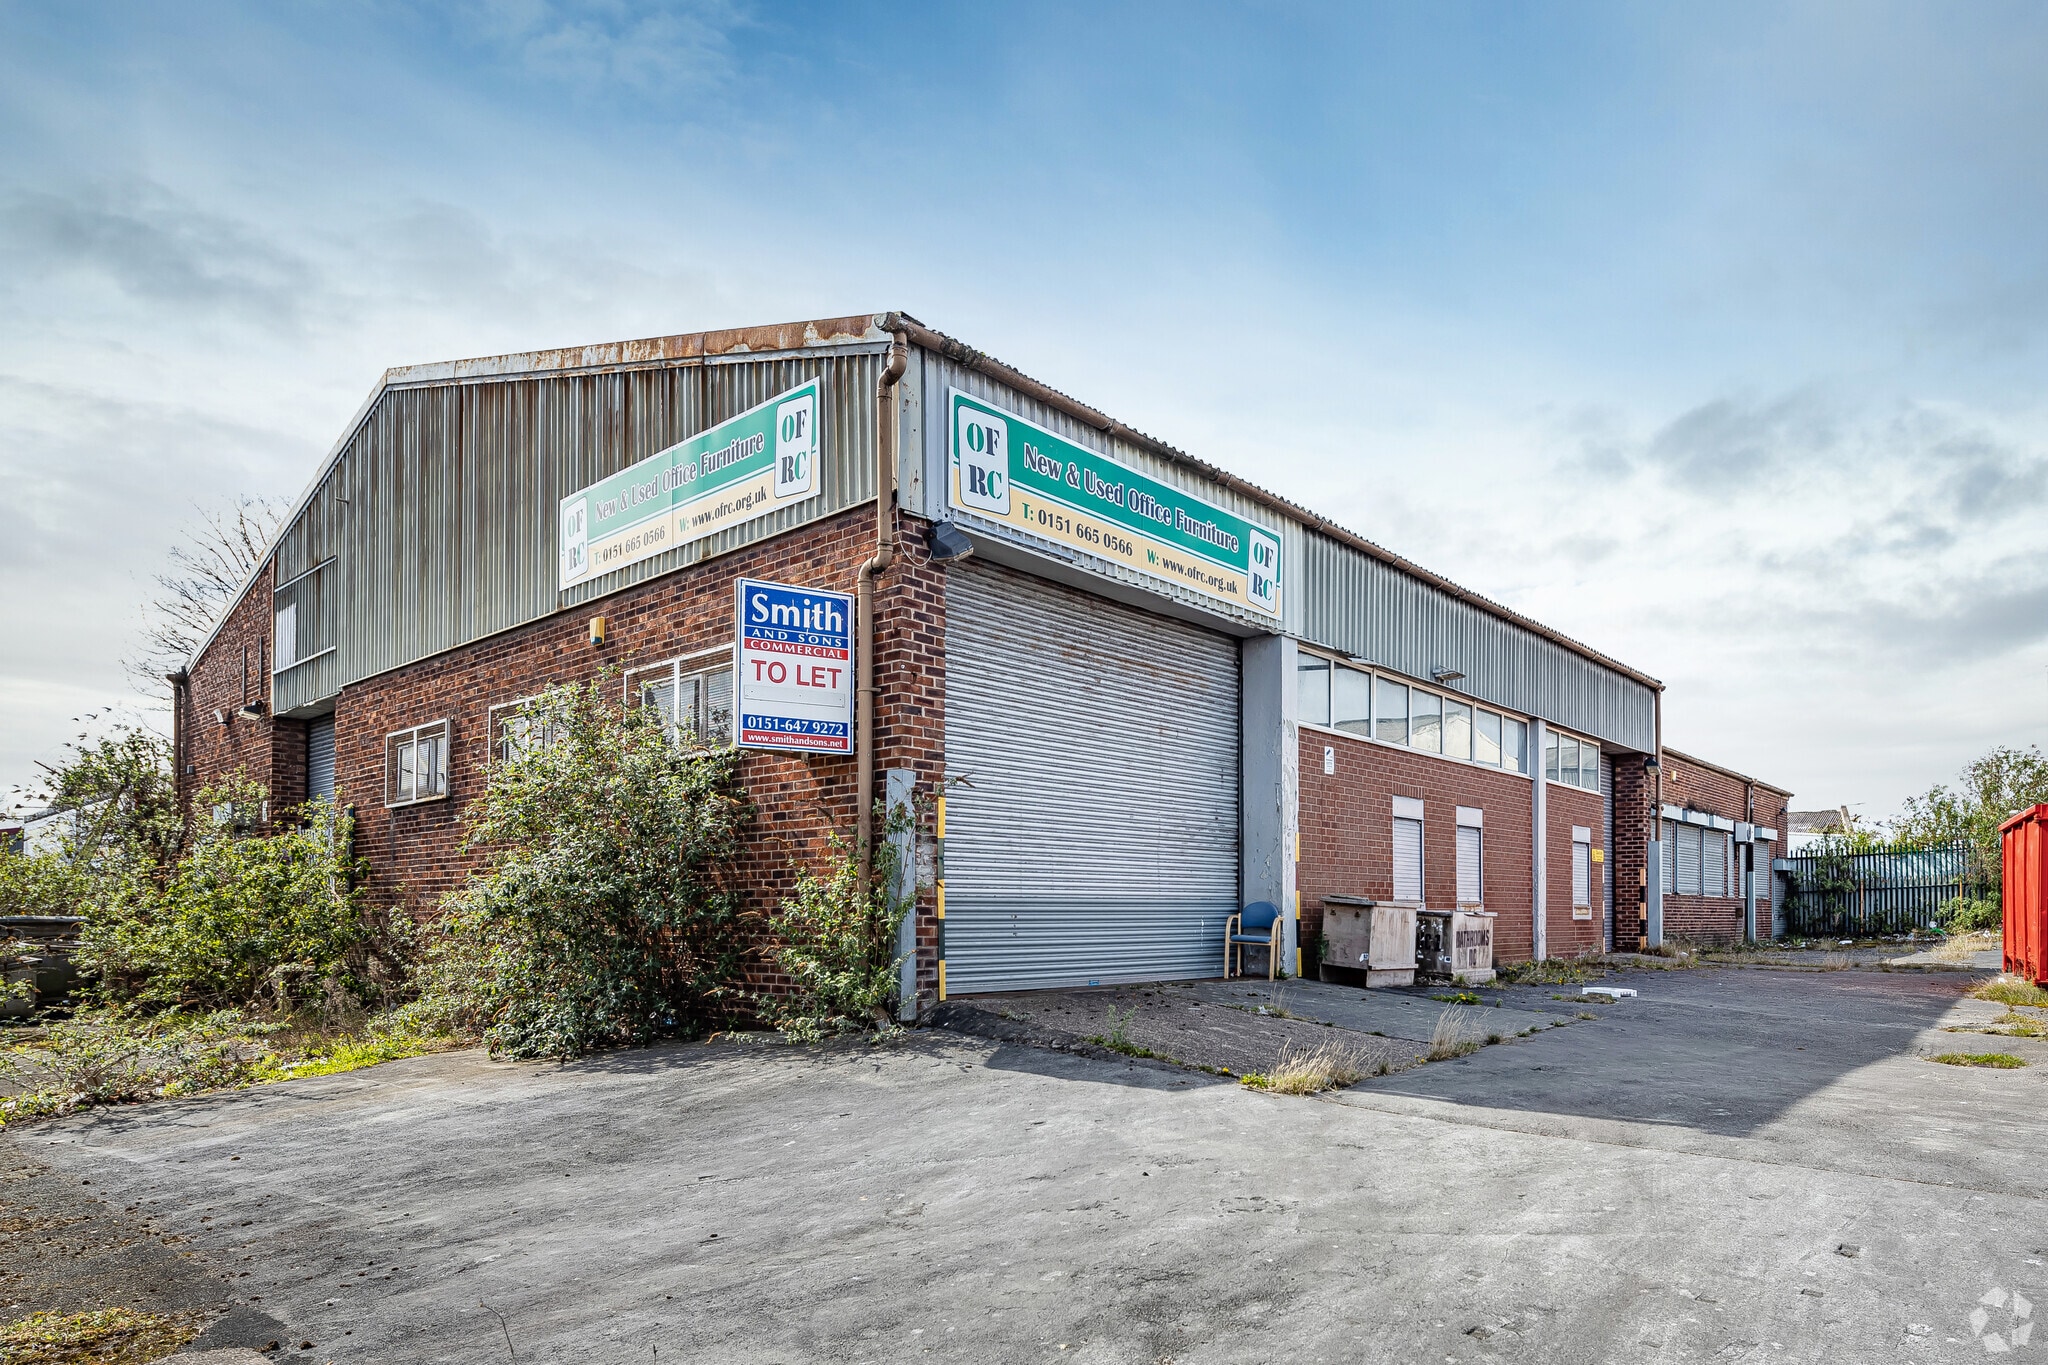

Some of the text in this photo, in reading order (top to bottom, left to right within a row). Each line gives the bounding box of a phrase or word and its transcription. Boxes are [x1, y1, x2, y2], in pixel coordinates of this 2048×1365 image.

[782, 409, 807, 442] OF
[967, 422, 1000, 456] OF
[595, 433, 764, 523] New & Used Office Furniture
[781, 451, 807, 484] RC
[969, 464, 1002, 499] RC
[679, 486, 767, 532] W: www.ofrc.org.uk
[1024, 443, 1239, 553] New & Used Office Furniture
[568, 509, 584, 537] OF
[1022, 503, 1133, 556] T: 0151 665 0566
[568, 541, 584, 571] RC
[594, 525, 665, 565] T: 0151 665 0566
[1253, 542, 1273, 568] OF
[1147, 549, 1238, 594] W: www.ofrc.org.uk
[1252, 572, 1272, 601] RC
[751, 593, 842, 632] Smith
[750, 639, 843, 659] COMMERCIAL
[752, 628, 842, 647] AND SONS
[751, 659, 842, 689] TO LET
[747, 734, 843, 748] www.smithandsons.net
[748, 715, 843, 735] 0151-647 9272
